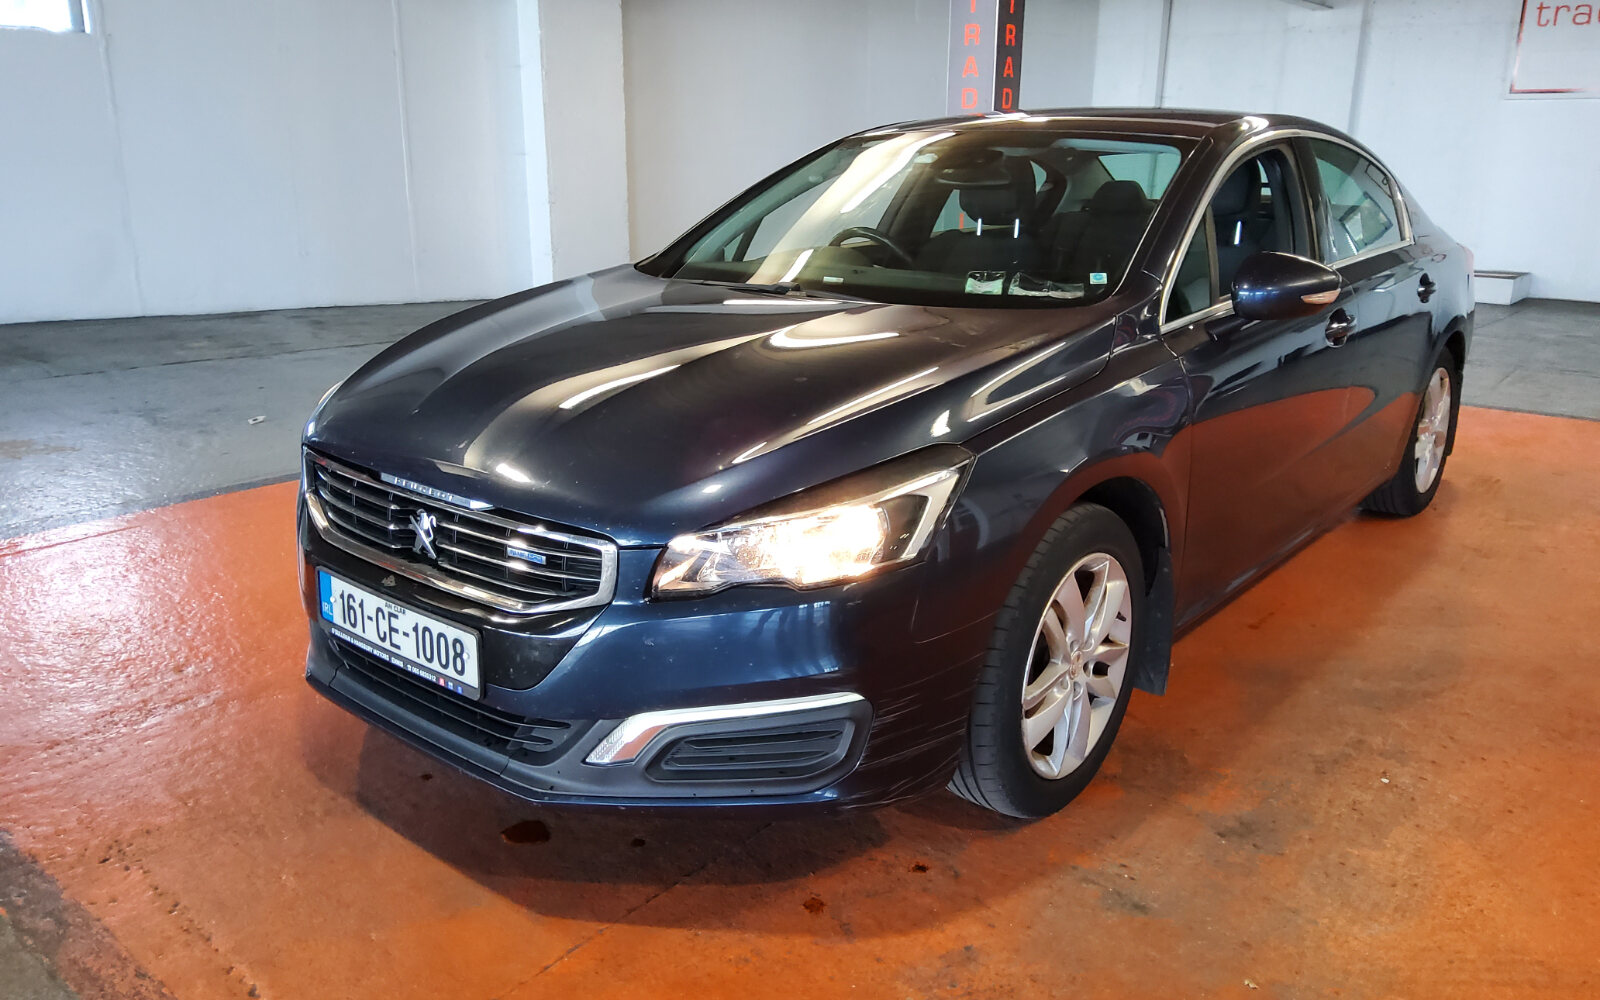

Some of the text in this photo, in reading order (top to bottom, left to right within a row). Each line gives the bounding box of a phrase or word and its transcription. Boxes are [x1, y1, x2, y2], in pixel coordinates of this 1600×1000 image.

[1536, 1, 1600, 27] tra
[322, 601, 333, 616] IRL
[339, 589, 466, 677] 161-CE-1008
